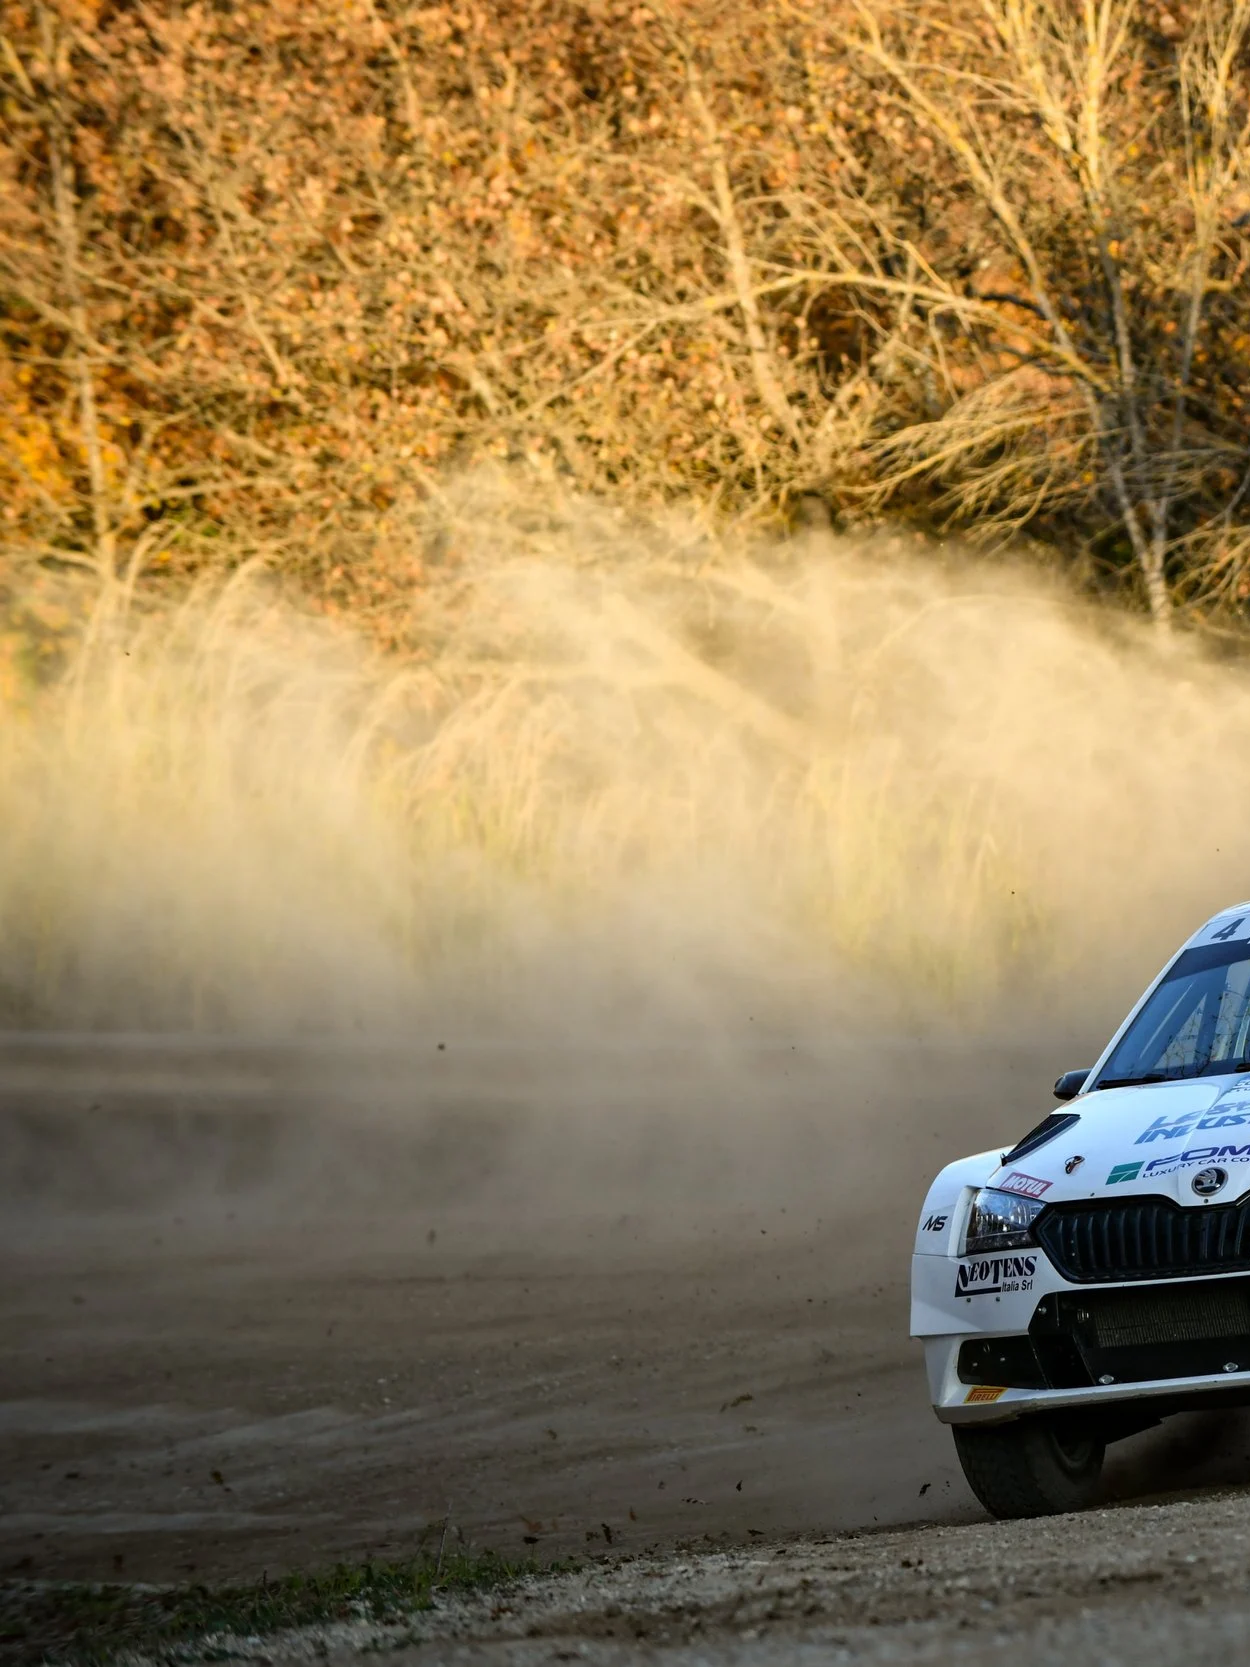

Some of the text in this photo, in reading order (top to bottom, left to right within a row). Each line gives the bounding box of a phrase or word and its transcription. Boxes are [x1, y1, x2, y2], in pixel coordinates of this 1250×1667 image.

[1210, 917, 1247, 941] 4
[1142, 1160, 1197, 1178] LUXURY
[1198, 1157, 1228, 1165] CAR
[1002, 1175, 1048, 1195] MOTUL
[922, 1215, 949, 1231] MS
[957, 1255, 1038, 1290] NEOTENS
[1001, 1279, 1033, 1293] Italia Srl
[967, 1388, 1004, 1402] PIRELLI
